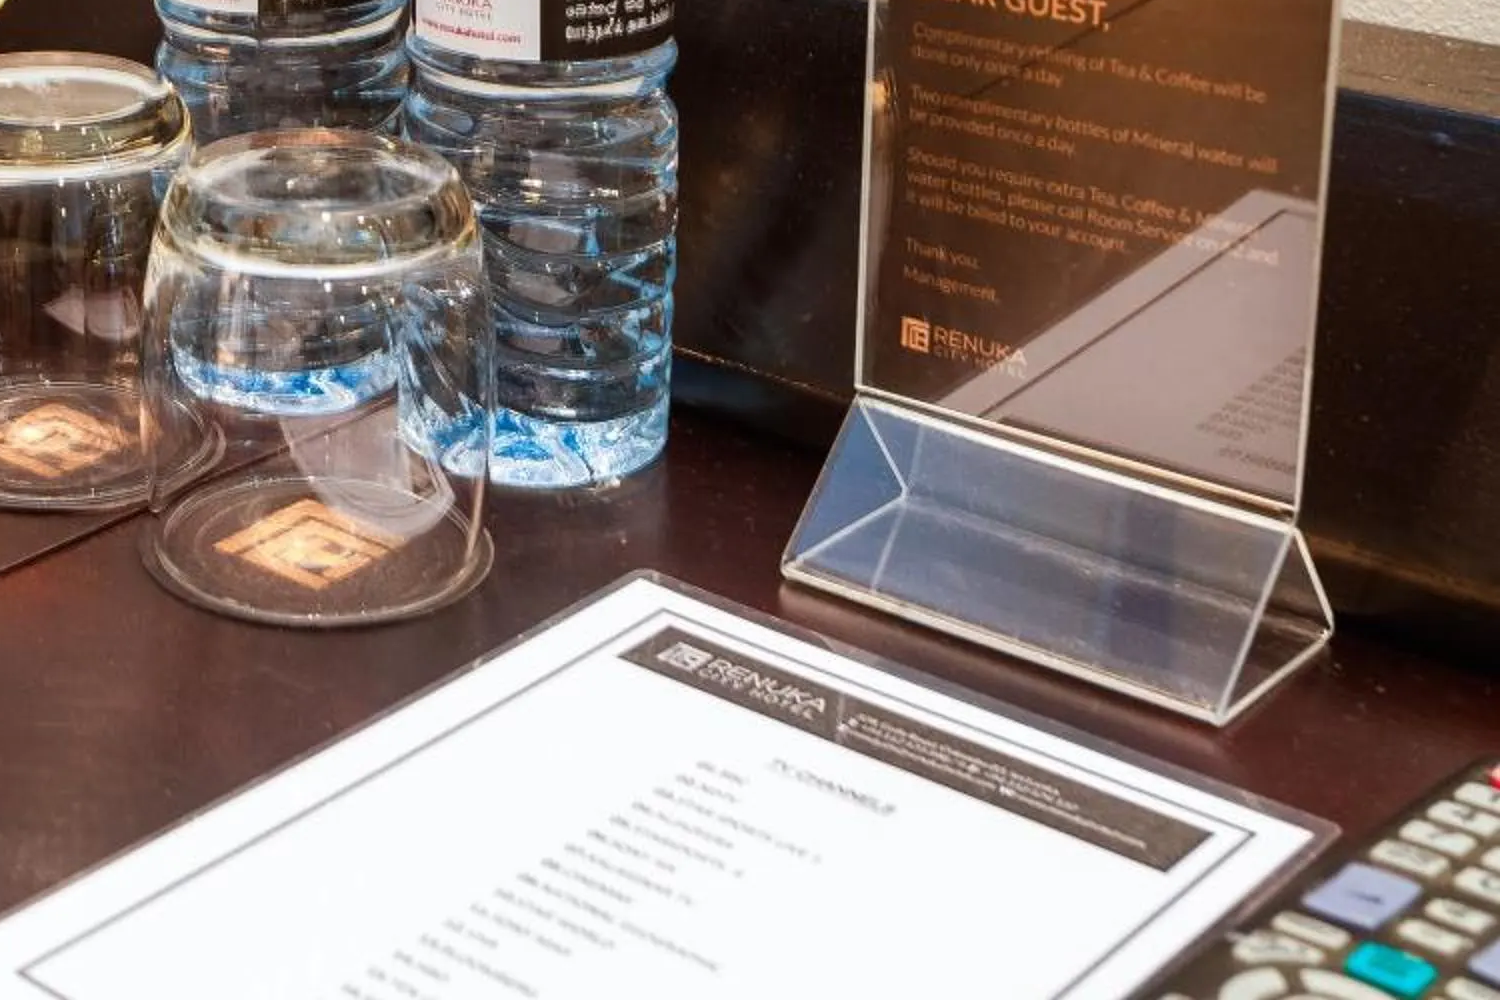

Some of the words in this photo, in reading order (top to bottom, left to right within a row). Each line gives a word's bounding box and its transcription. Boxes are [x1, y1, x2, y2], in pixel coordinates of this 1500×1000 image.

[951, 51, 983, 73] only
[1110, 58, 1137, 79] Tea
[1139, 63, 1153, 82] &
[1155, 67, 1211, 93] Coffee
[1212, 82, 1243, 100] will
[1244, 84, 1268, 104] be
[910, 82, 941, 105] Two
[1055, 114, 1110, 140] bottles
[1112, 128, 1130, 144] of
[1131, 129, 1196, 160] Mineral
[1196, 146, 1244, 168] water
[1247, 155, 1279, 174] will
[928, 112, 996, 138] provided
[997, 128, 1034, 146] once
[906, 146, 958, 170] Should
[958, 160, 987, 180] you
[988, 167, 1044, 192] require
[1046, 180, 1086, 200] extra
[1120, 194, 1176, 220] Coffee
[1177, 206, 1192, 224] &
[906, 170, 948, 189] water
[1006, 191, 1056, 214] please
[1057, 203, 1084, 222] call
[1086, 207, 1134, 232] Room
[918, 193, 944, 210] will
[945, 198, 966, 214] be
[1009, 212, 1026, 230] to
[1027, 219, 1061, 239] your
[905, 236, 946, 262] Thank
[933, 325, 1028, 368] RENUKA
[706, 657, 826, 713] RENUKA
